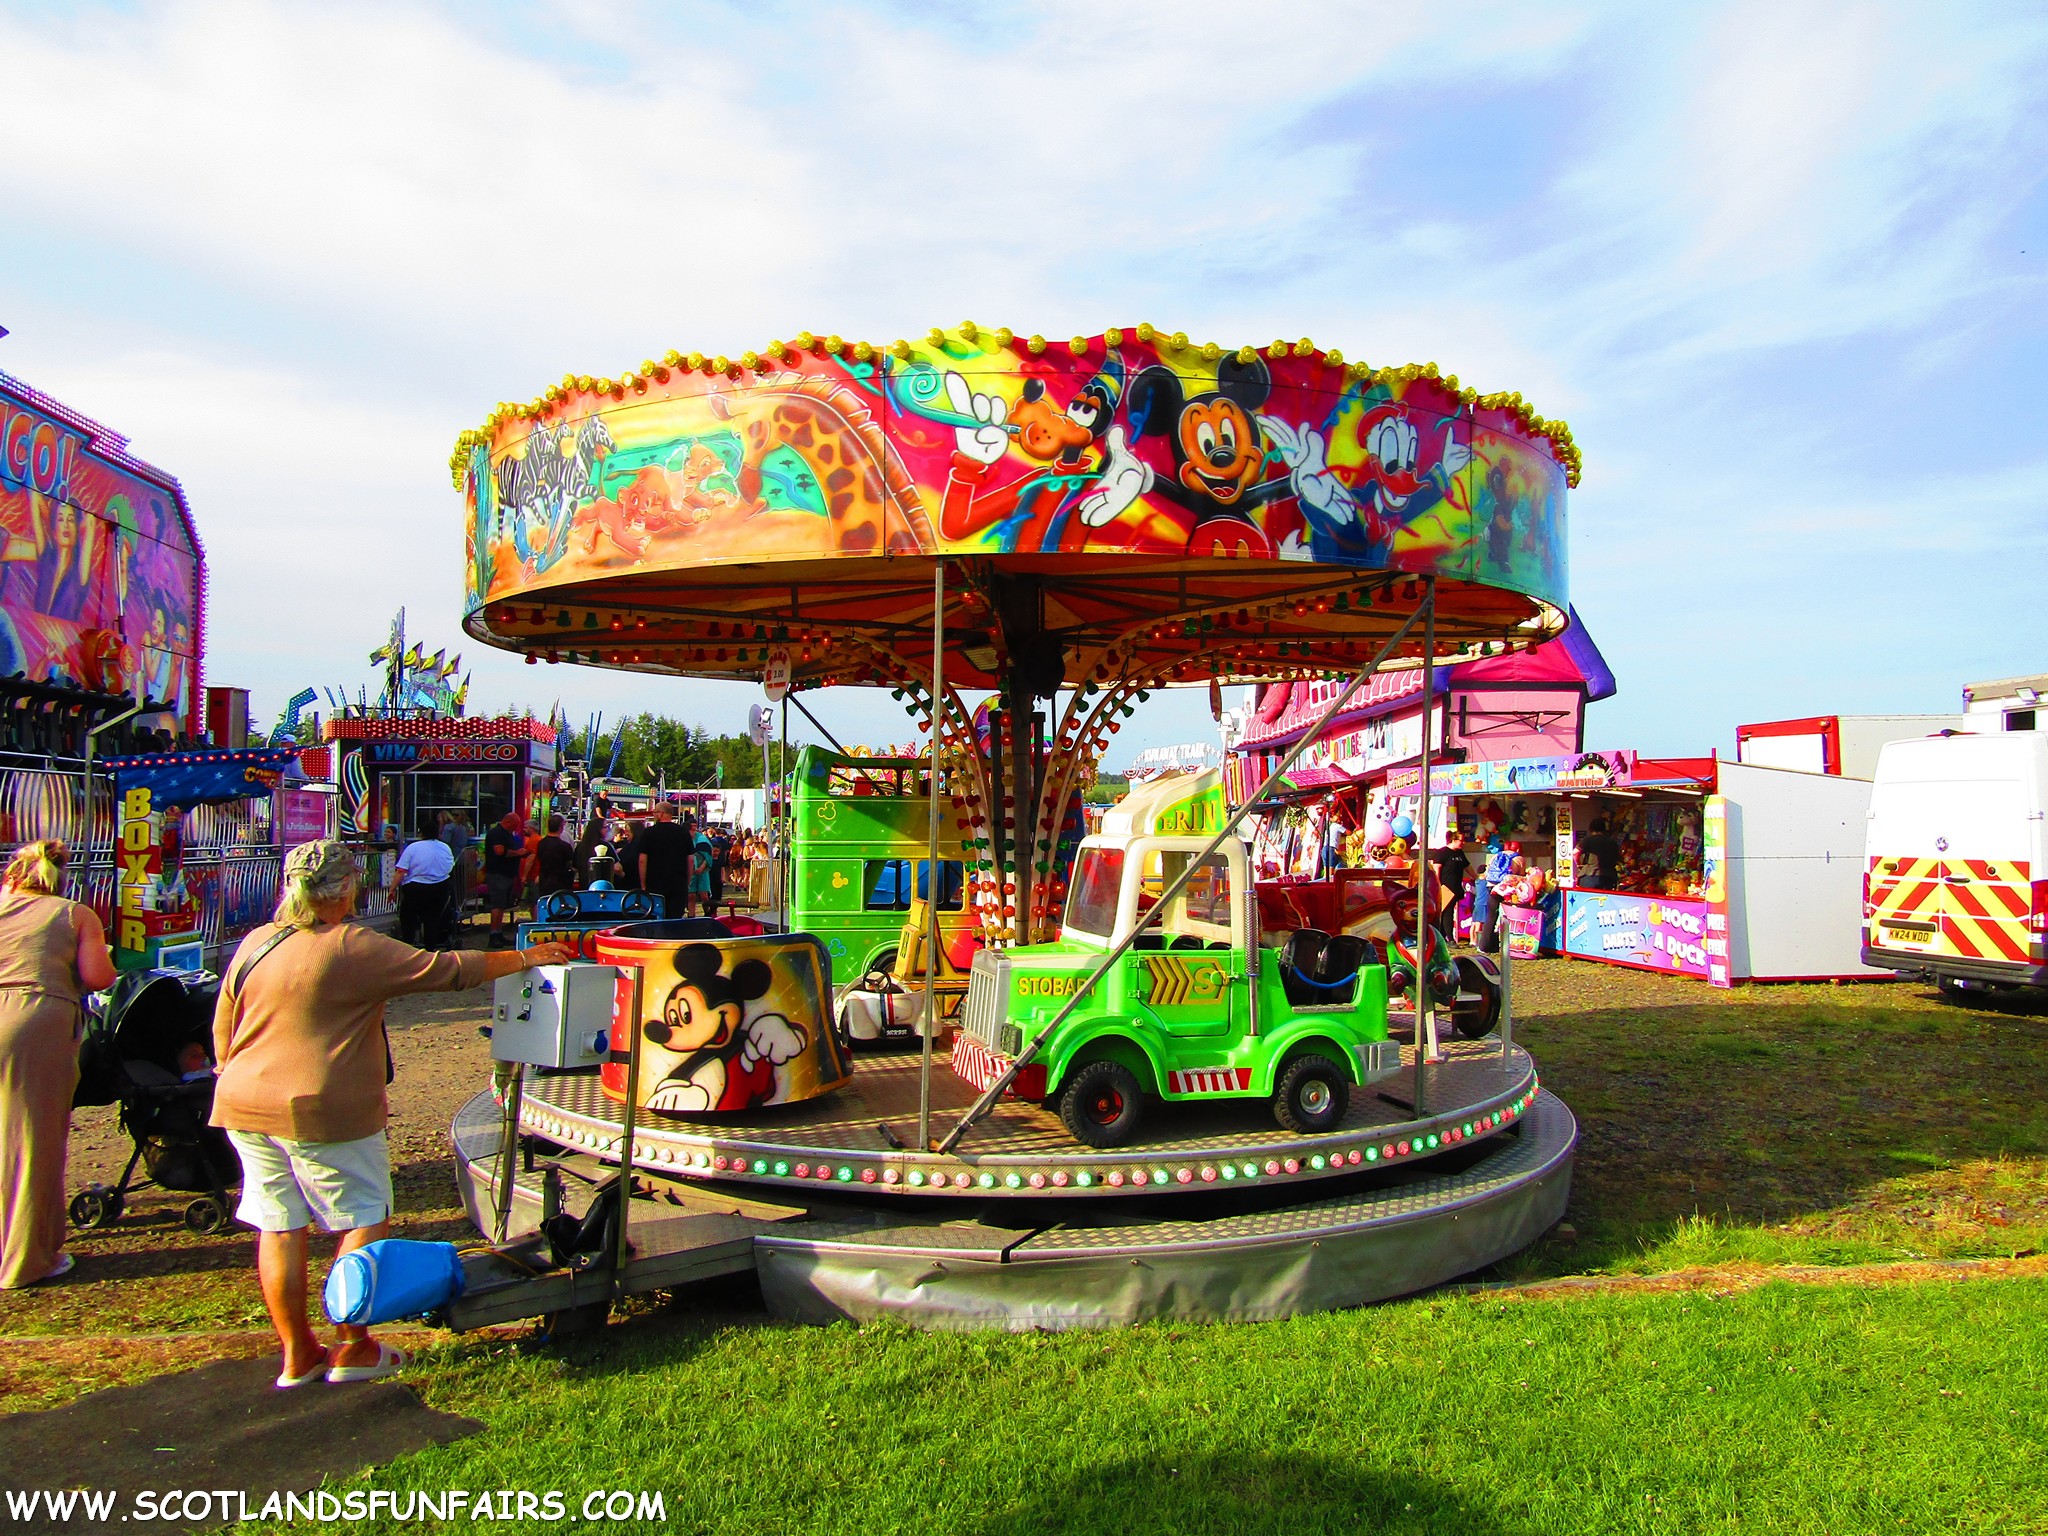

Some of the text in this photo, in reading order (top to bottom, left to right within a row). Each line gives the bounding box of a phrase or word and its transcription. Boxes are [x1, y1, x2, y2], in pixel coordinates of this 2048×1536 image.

[374, 743, 518, 761] VIVA MEXICO
[1430, 771, 1454, 791] OYS
[1518, 763, 1556, 787] TOYS
[1557, 768, 1605, 787] DARTS
[1160, 800, 1218, 831] ERIN
[120, 787, 153, 953] BOXER
[1597, 905, 1640, 928] TRY THE
[1661, 905, 1702, 935] HOOK
[1602, 931, 1637, 951] DARTS
[1889, 928, 1929, 942] KW24 WDD
[1653, 931, 1707, 968] A DUCK
[1193, 967, 1219, 995] S
